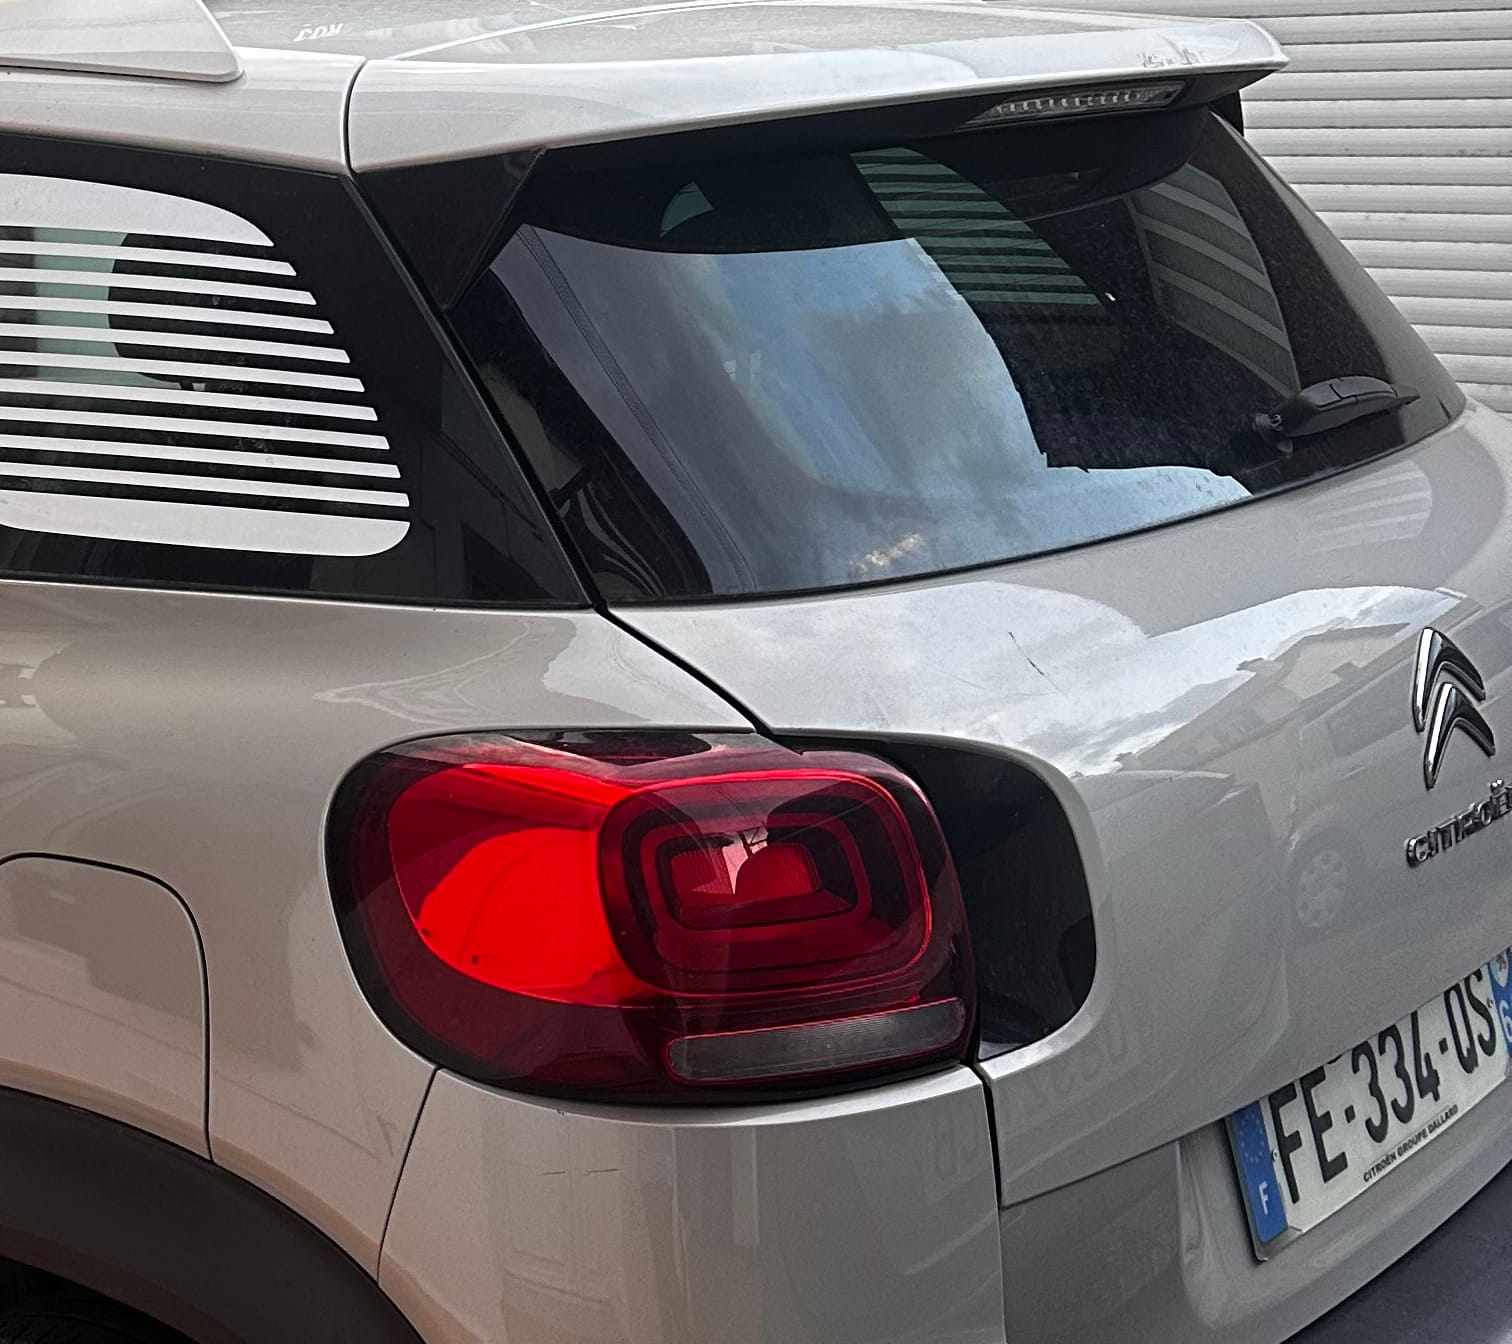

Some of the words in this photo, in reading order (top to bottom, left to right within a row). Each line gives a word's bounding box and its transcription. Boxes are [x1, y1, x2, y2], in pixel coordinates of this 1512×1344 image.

[1268, 969, 1497, 1204] FE-334-QS
[1397, 1128, 1428, 1157] GROUPE
[1259, 1181, 1268, 1215] F
